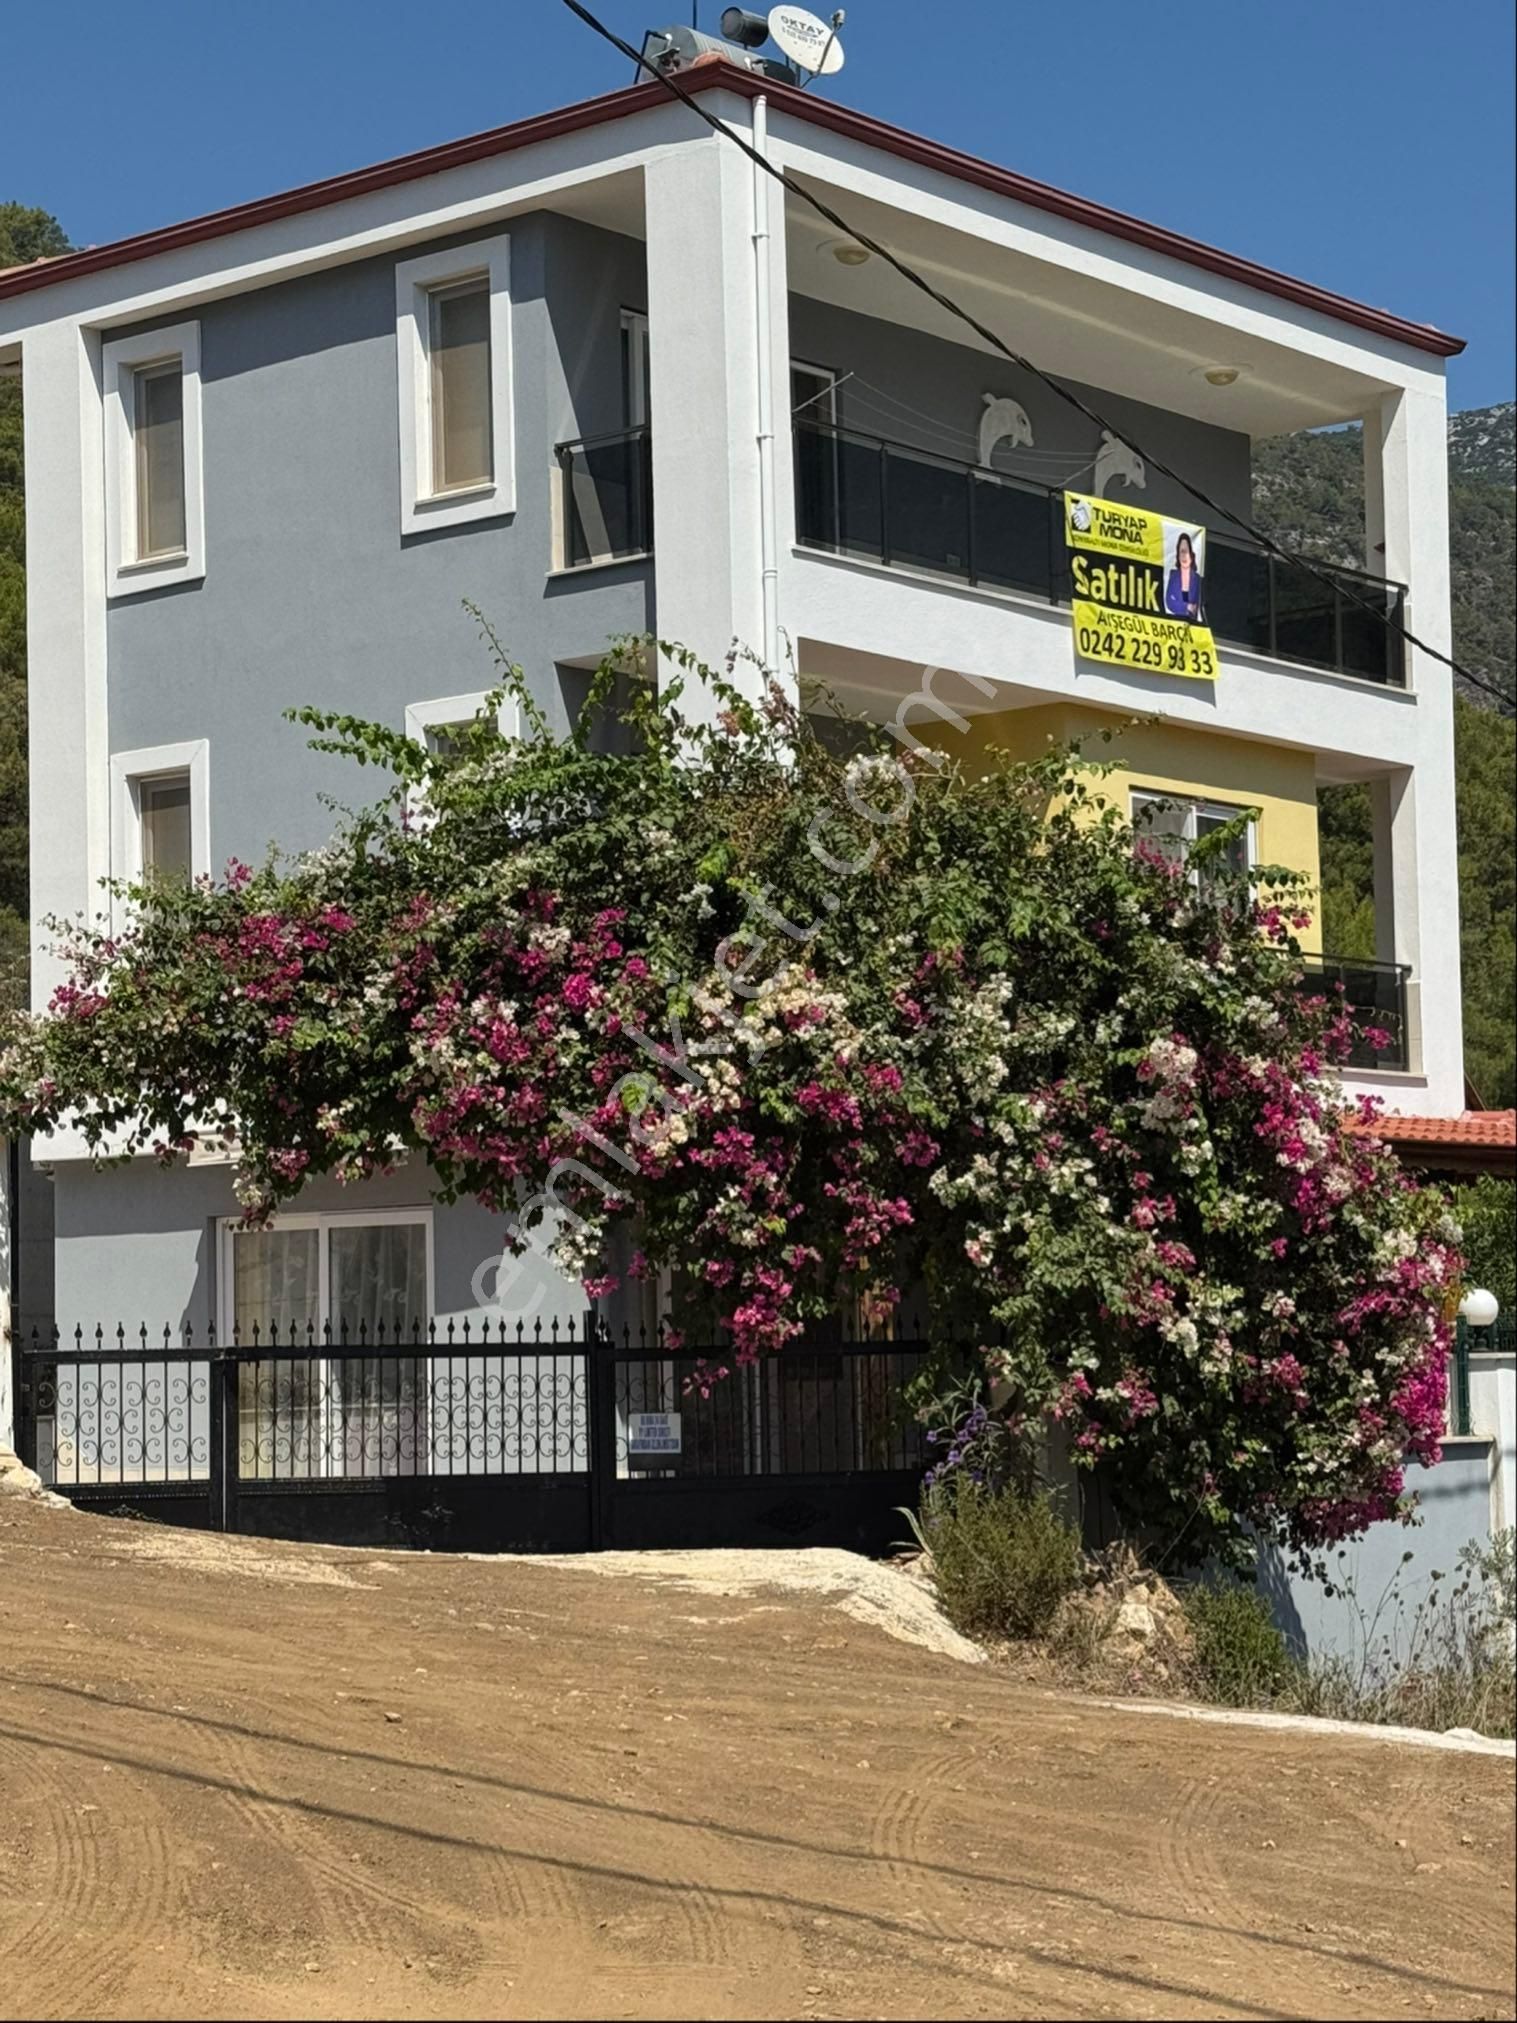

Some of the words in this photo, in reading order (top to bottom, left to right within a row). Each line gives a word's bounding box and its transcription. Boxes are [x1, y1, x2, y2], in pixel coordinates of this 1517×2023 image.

[781, 15, 824, 35] OKTAY
[1093, 507, 1148, 531] TURYAP
[1100, 524, 1144, 545] MONA
[1072, 555, 1160, 612] Satılık
[1080, 628, 1126, 659] 0242
[1131, 637, 1162, 667] 229
[1168, 645, 1186, 671] 93
[1190, 650, 1213, 675] 33
